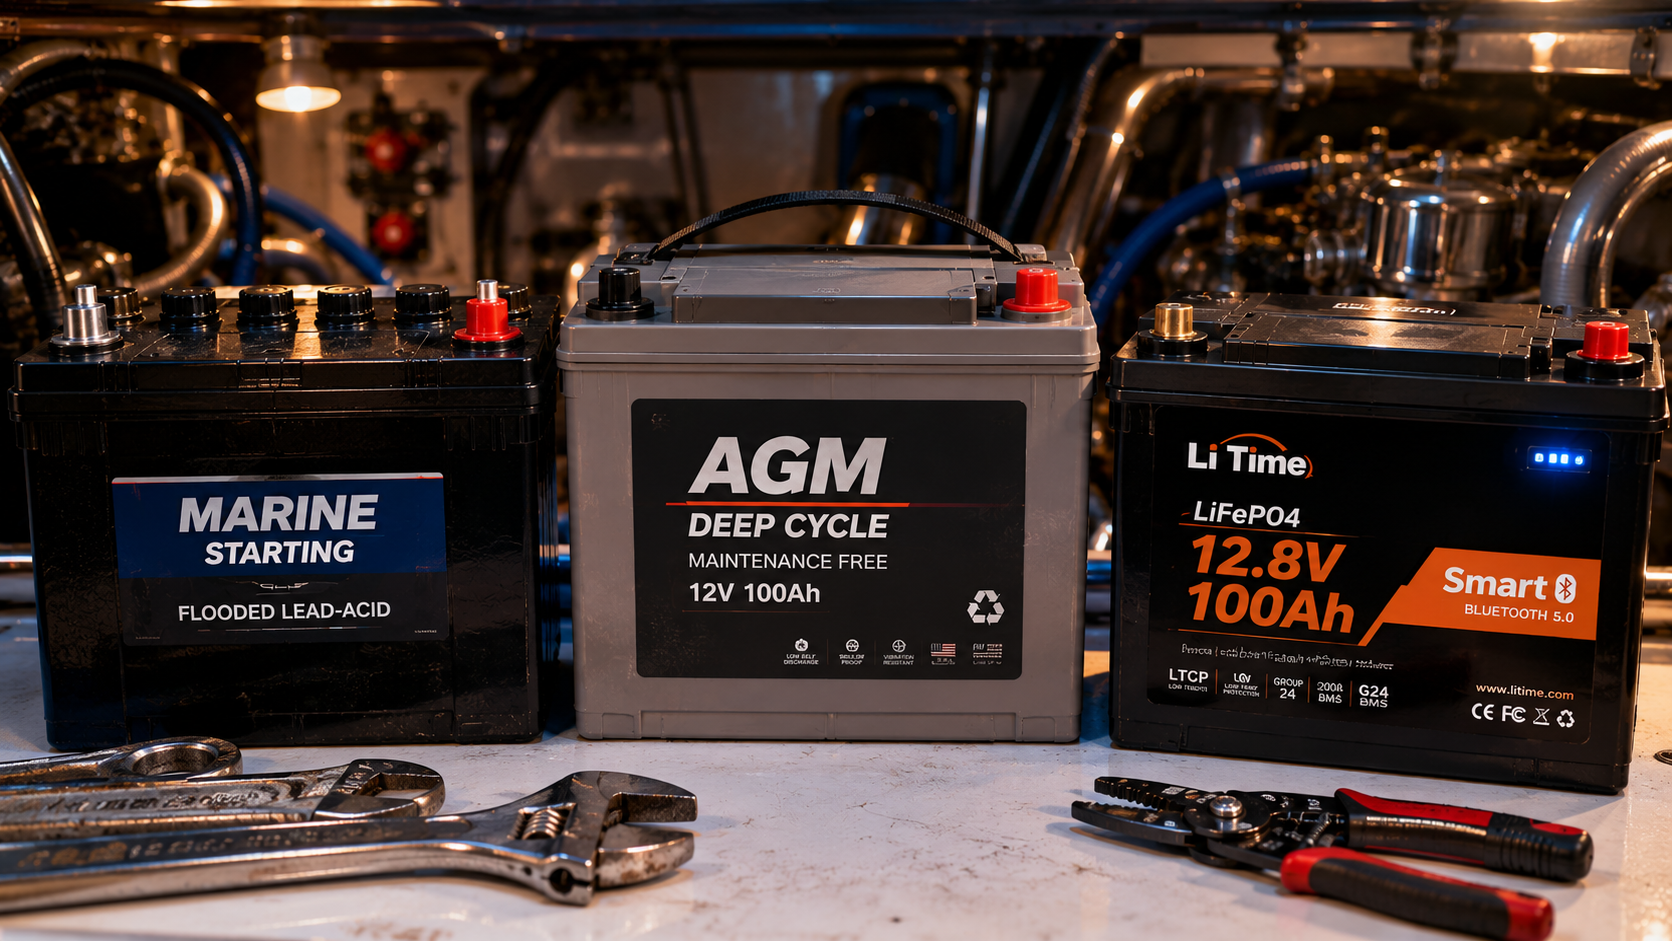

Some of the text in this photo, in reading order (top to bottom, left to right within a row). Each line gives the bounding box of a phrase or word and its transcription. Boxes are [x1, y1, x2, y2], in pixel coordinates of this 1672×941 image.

[687, 435, 887, 495] AGM
[1187, 442, 1308, 477] Li Time
[178, 494, 379, 533] MARINE
[688, 512, 890, 539] DEEP CYCLE
[204, 539, 355, 566] STARTING
[688, 552, 888, 570] MAINTENANCE FREE
[1191, 534, 1347, 583] 12.8V
[689, 582, 820, 603] 12V 100Ah
[1442, 566, 1548, 601] Smart
[178, 601, 391, 622] FLOODED LEAD-ACID
[1188, 582, 1355, 634] 100Ah
[1464, 603, 1574, 623] BLUETOOTH 5.0
[1168, 668, 1209, 684] LTCP
[1273, 676, 1304, 688] GROUP
[1279, 688, 1297, 700] 24
[1318, 693, 1343, 704] BMS
[1358, 684, 1389, 699] G24
[1475, 683, 1575, 701] www.litime.com
[1359, 697, 1389, 708] BMS
[1471, 702, 1495, 721] CE
